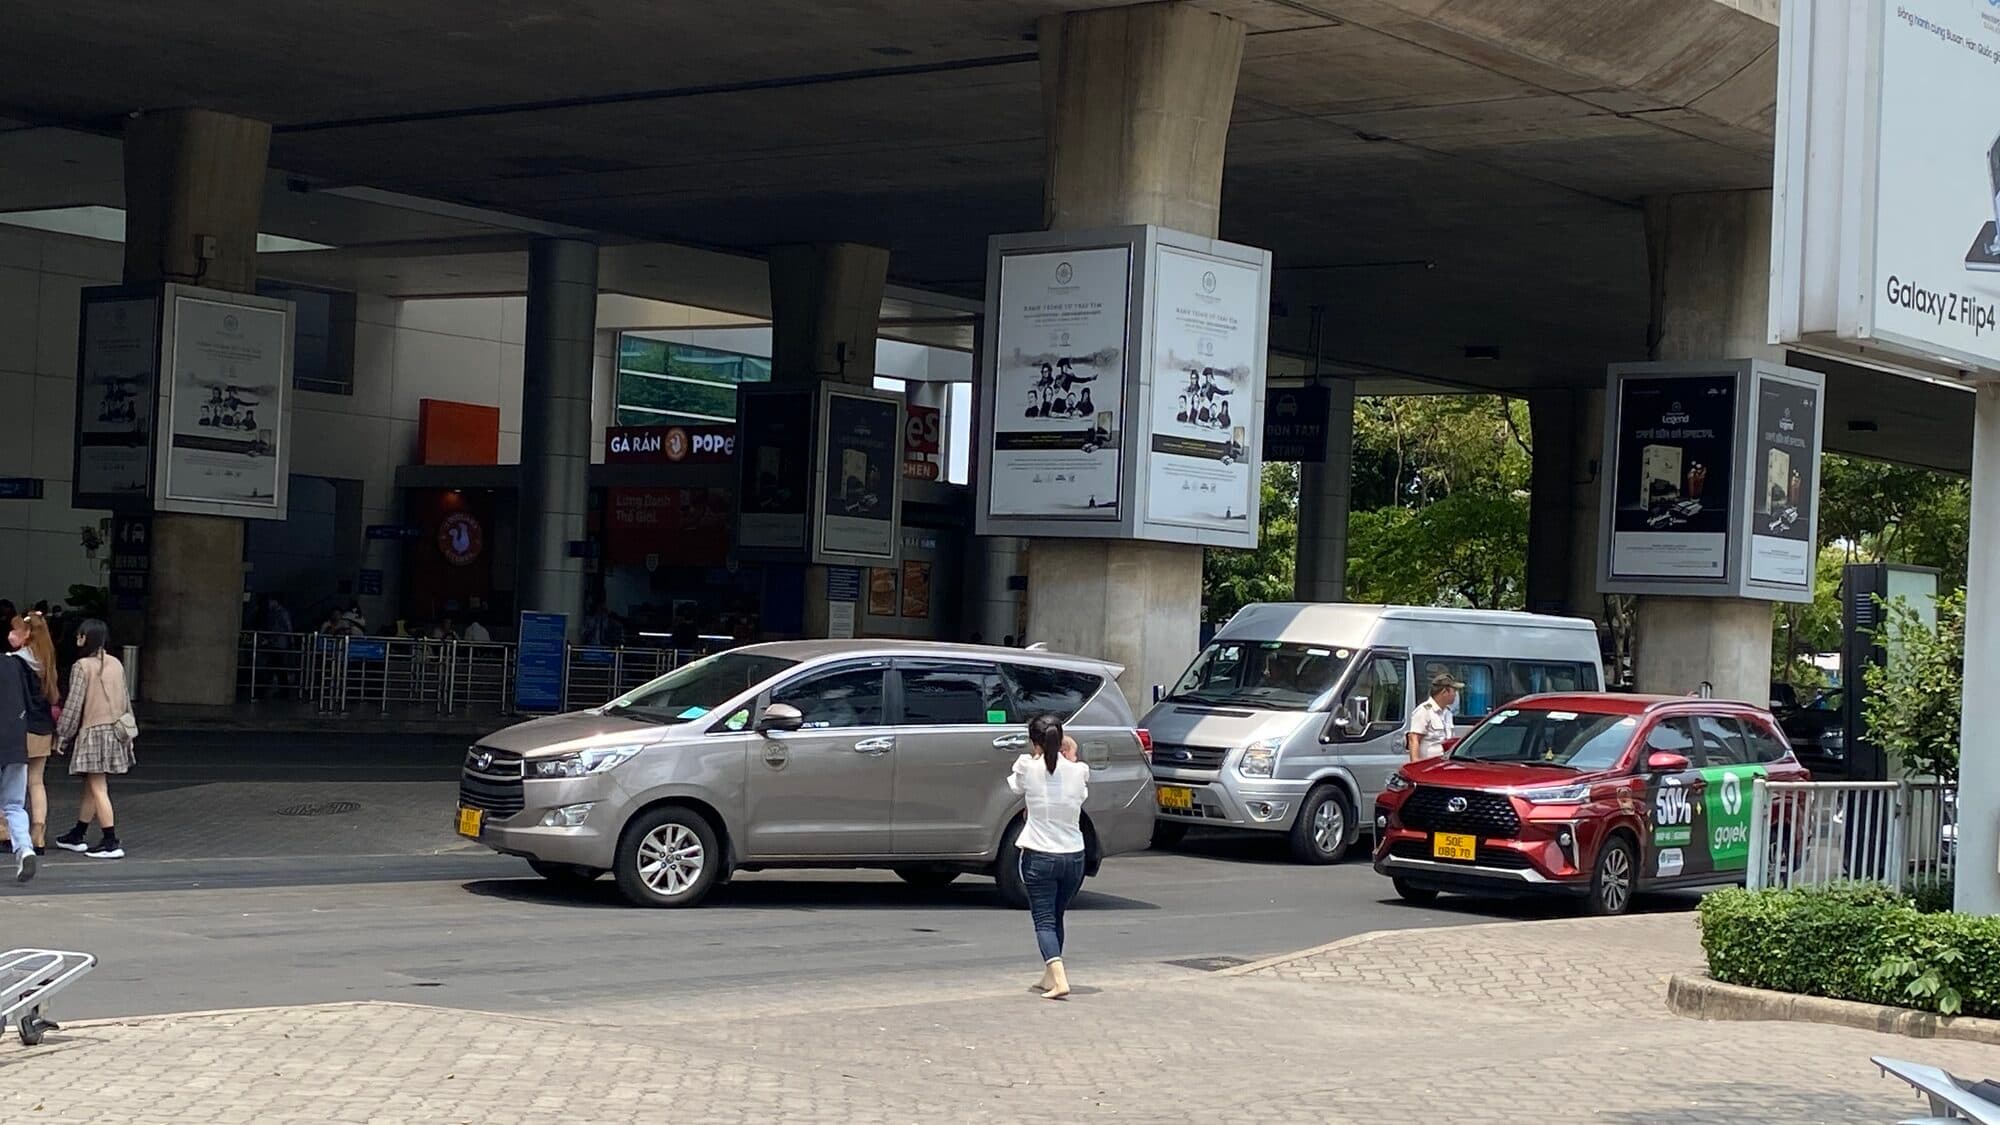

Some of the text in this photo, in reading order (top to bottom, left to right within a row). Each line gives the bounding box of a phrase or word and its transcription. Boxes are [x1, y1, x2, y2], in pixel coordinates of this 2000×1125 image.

[1887, 275, 1996, 336] Galaxy Z Flip4
[633, 431, 661, 452] RÁN
[1656, 787, 1691, 825] 50%
[1714, 822, 1747, 849] gojek
